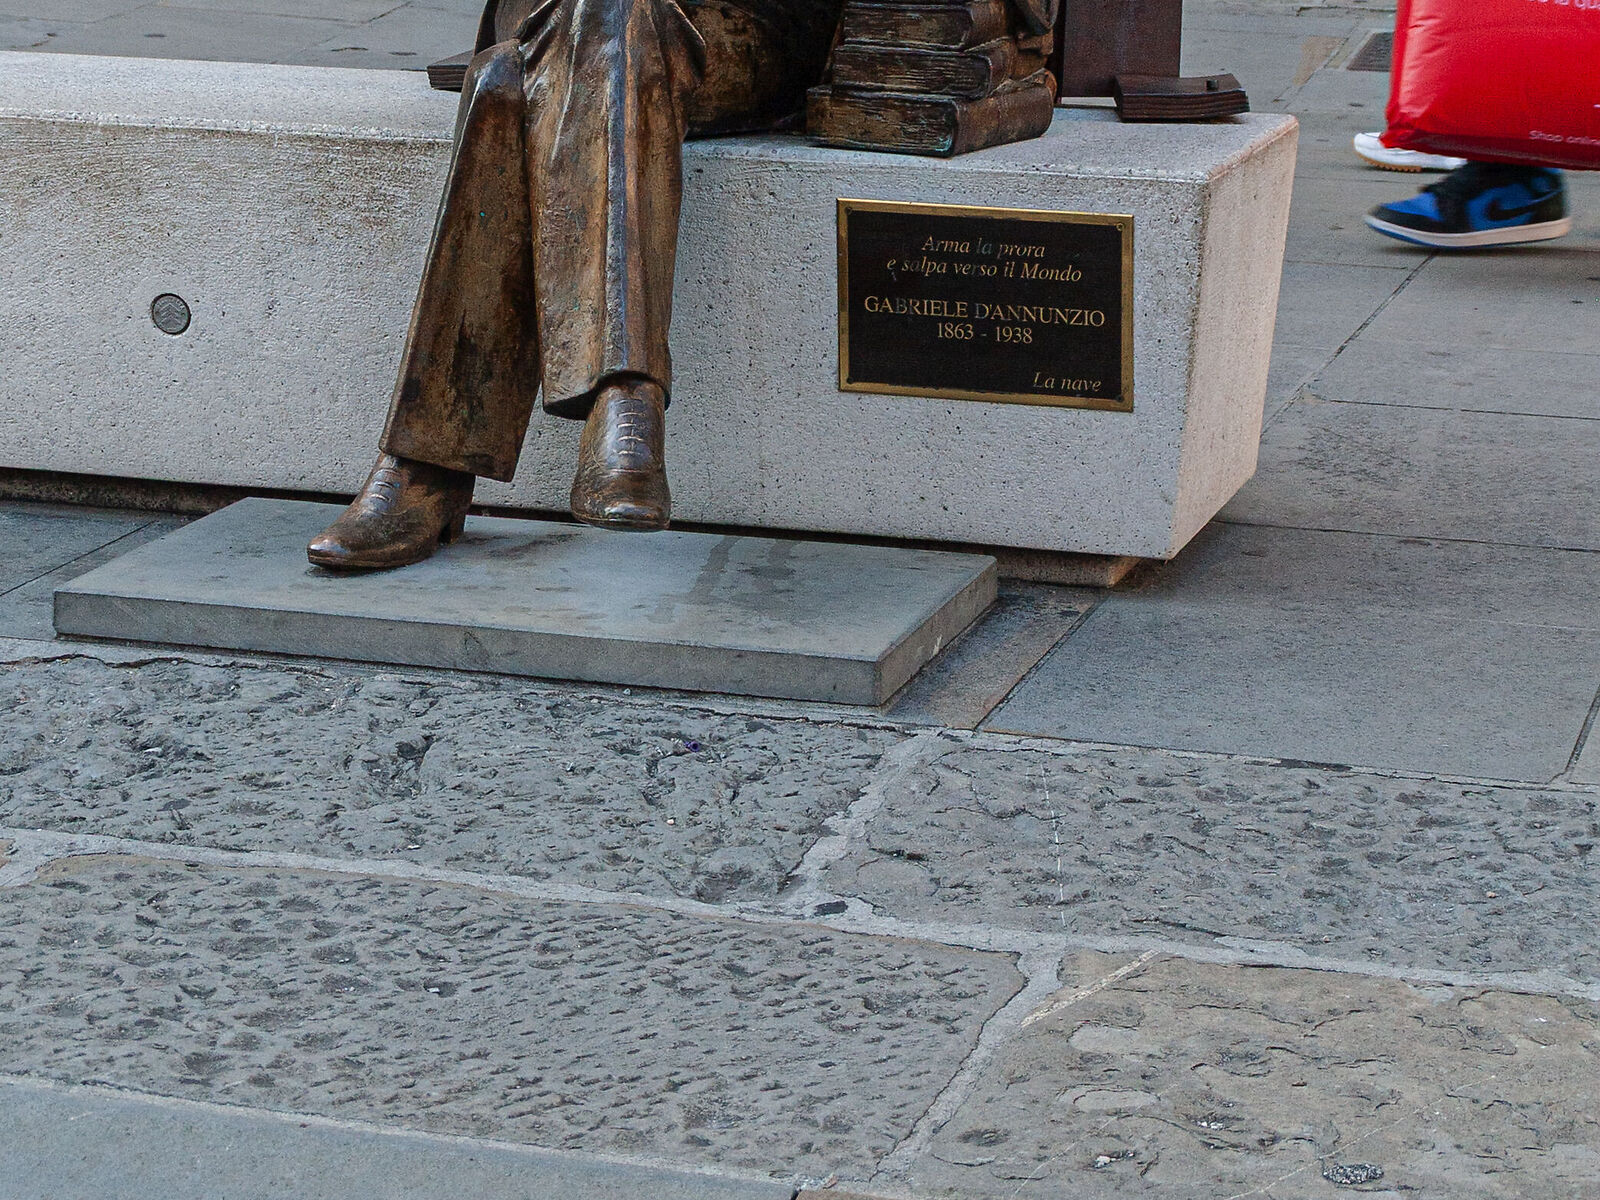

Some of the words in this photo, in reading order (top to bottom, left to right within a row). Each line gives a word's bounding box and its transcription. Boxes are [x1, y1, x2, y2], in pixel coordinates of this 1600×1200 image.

[921, 236, 970, 253] Arma
[976, 238, 993, 255] la
[997, 244, 1046, 259] prora
[886, 259, 897, 270] e
[901, 256, 948, 277] salpa
[953, 262, 998, 277] verso
[1003, 261, 1016, 278] il
[1020, 262, 1082, 282] Mondo
[864, 295, 969, 318] GABRIELE
[974, 302, 1105, 327] D'ANNUNZIO
[937, 322, 974, 340] 1863
[995, 326, 1033, 344] 1938
[1033, 372, 1055, 389] La
[1060, 377, 1101, 392] nave
